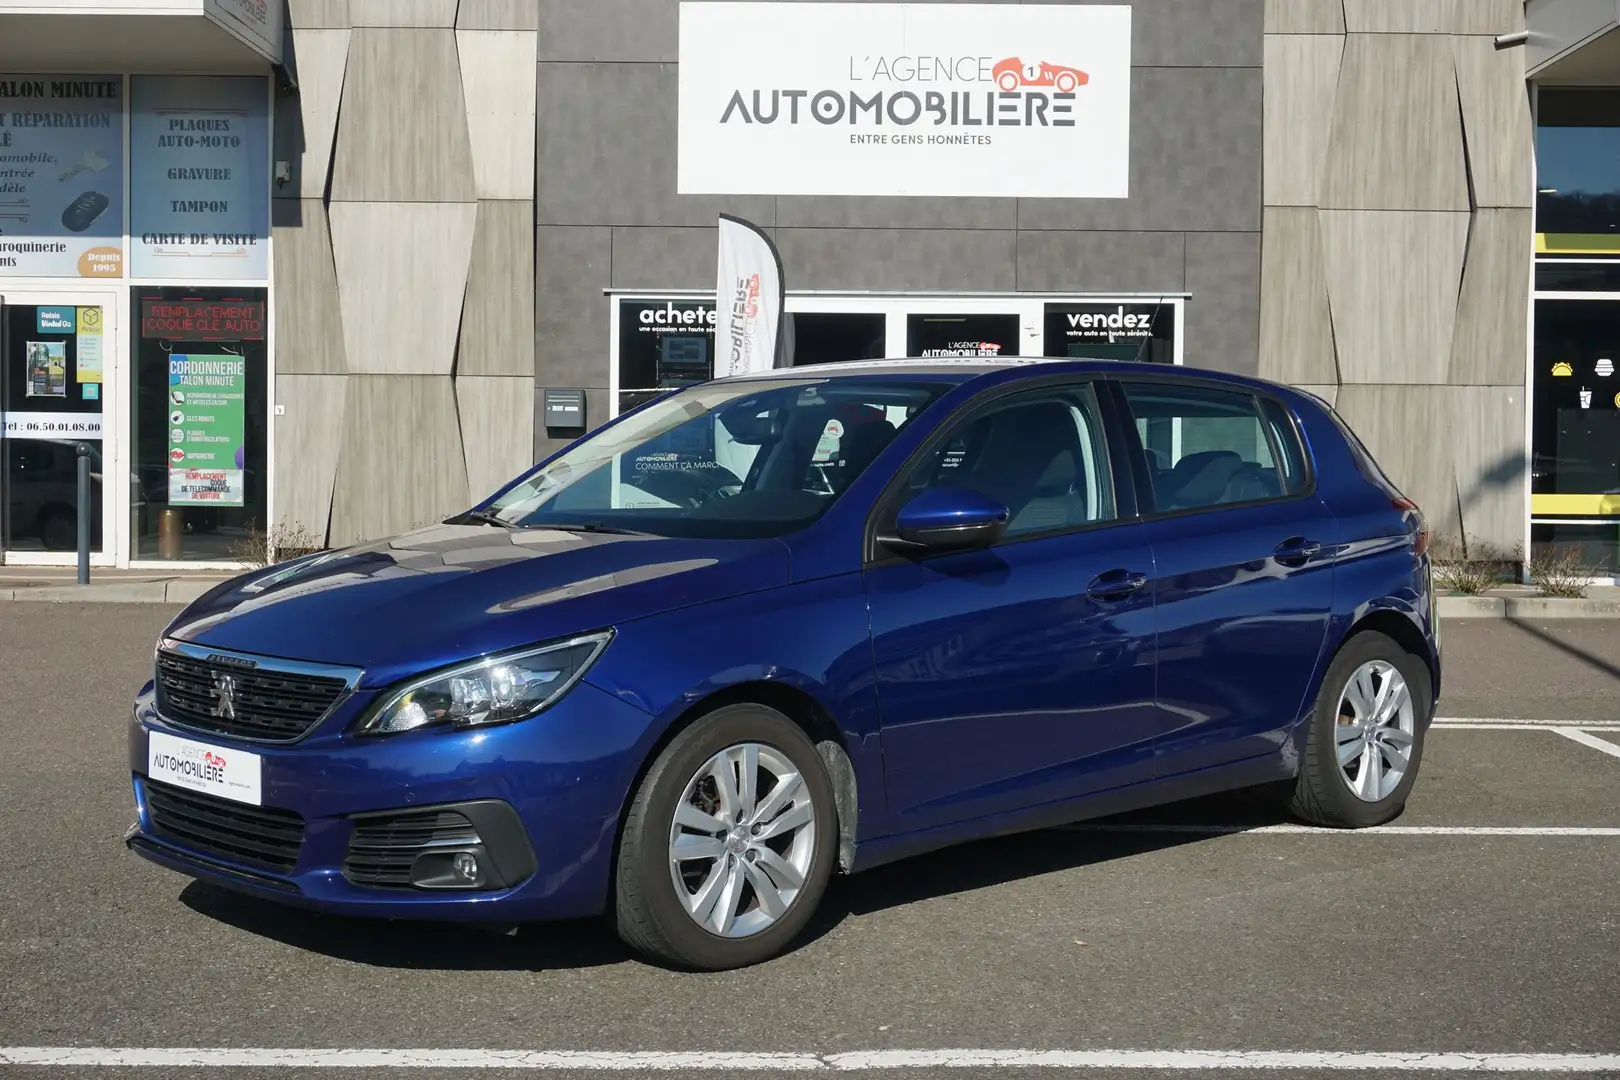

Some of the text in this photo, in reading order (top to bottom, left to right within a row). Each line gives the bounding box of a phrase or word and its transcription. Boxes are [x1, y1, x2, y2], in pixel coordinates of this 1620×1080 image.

[850, 56, 992, 81] L'AGENCE
[51, 81, 117, 98] MINUTE
[719, 89, 1076, 127] AUTOMOBILIERE
[12, 110, 110, 128] RÉPARATION
[169, 119, 230, 132] PLAQUES
[158, 135, 241, 147] AUTO-MOTO
[850, 132, 992, 145] ENTRE GENS HONNÊTES
[168, 168, 231, 180] GRAVURE
[170, 200, 228, 212] TAMPON
[142, 232, 257, 245] CARTE DE VISITE
[88, 253, 120, 262] Depuis
[93, 264, 116, 272] 1995
[41, 311, 61, 319] Relais
[152, 305, 255, 318] REMPLACEMENT
[1067, 305, 1150, 328] vendez
[147, 318, 261, 332] COQUE CLE AUTO
[652, 325, 678, 333] occasion
[948, 341, 980, 349] L'AGENCE
[170, 361, 244, 375] CORDONNERIE
[179, 375, 234, 387] TALON MINUTE
[27, 422, 101, 432] 06.50.01.08.00
[635, 462, 679, 470] COMMENT
[186, 472, 227, 480] REMPLACEMENT
[154, 752, 224, 784] AUTOMOBILIERE
